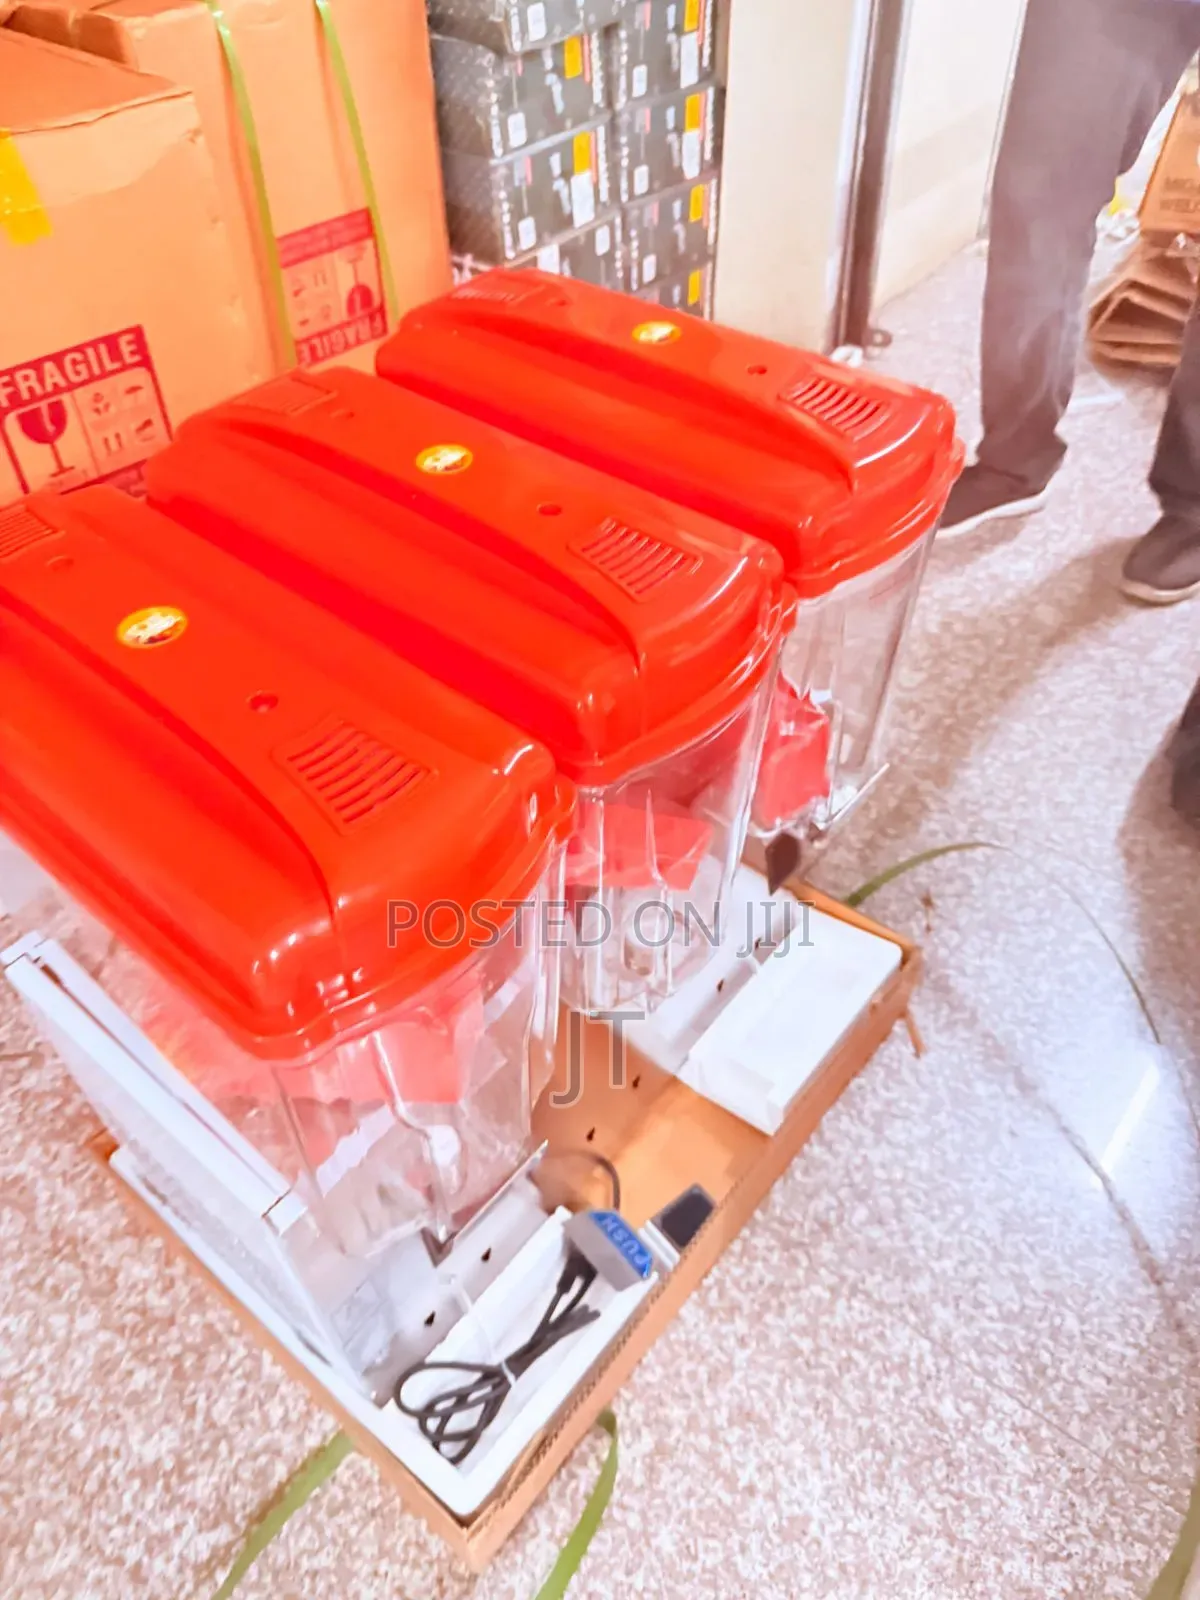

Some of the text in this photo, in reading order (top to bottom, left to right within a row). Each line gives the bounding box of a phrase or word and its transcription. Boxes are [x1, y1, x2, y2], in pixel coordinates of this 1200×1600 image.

[299, 312, 385, 366] FRAGILE
[0, 333, 142, 408] FRAGILE
[601, 1214, 651, 1266] PUSH
